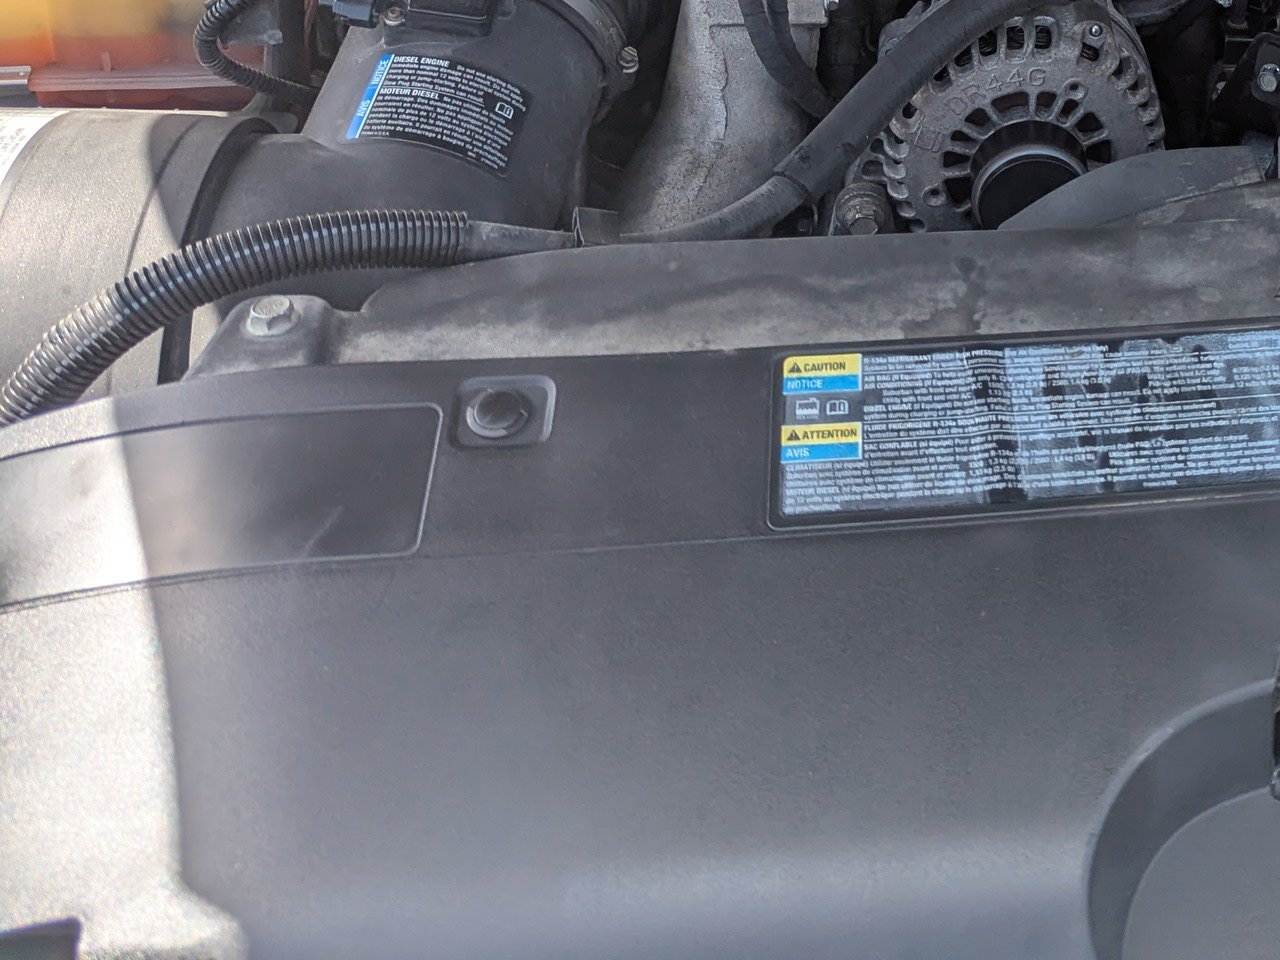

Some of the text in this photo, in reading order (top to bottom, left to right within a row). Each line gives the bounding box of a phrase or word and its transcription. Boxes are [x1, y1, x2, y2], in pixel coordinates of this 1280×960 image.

[370, 59, 389, 85] NOTICE
[421, 57, 450, 68] ENGINE
[486, 75, 507, 88] starting
[411, 81, 433, 89] Starting
[434, 84, 455, 93] System
[440, 68, 462, 77] damage
[493, 82, 500, 90] Do
[501, 87, 510, 95] not
[457, 83, 477, 93] Failure
[469, 81, 493, 94] electrical
[380, 88, 411, 96] MOTEUR
[412, 89, 439, 100] DIESEL
[356, 100, 371, 117] AVIS
[399, 113, 418, 121] charge
[437, 114, 451, 122] volts
[420, 123, 442, 133] pourrait
[804, 361, 846, 372] CAUTION
[787, 379, 823, 390] NOTICE
[876, 380, 923, 389] CONDITIONING
[928, 386, 945, 394] front
[863, 405, 887, 413] DIESEL
[888, 403, 912, 411] ENGINE
[909, 410, 938, 418] charging
[863, 423, 887, 431] FLUIDE
[802, 428, 858, 440] ATTENTION
[786, 447, 810, 458] AVIS
[863, 443, 879, 451] SAC
